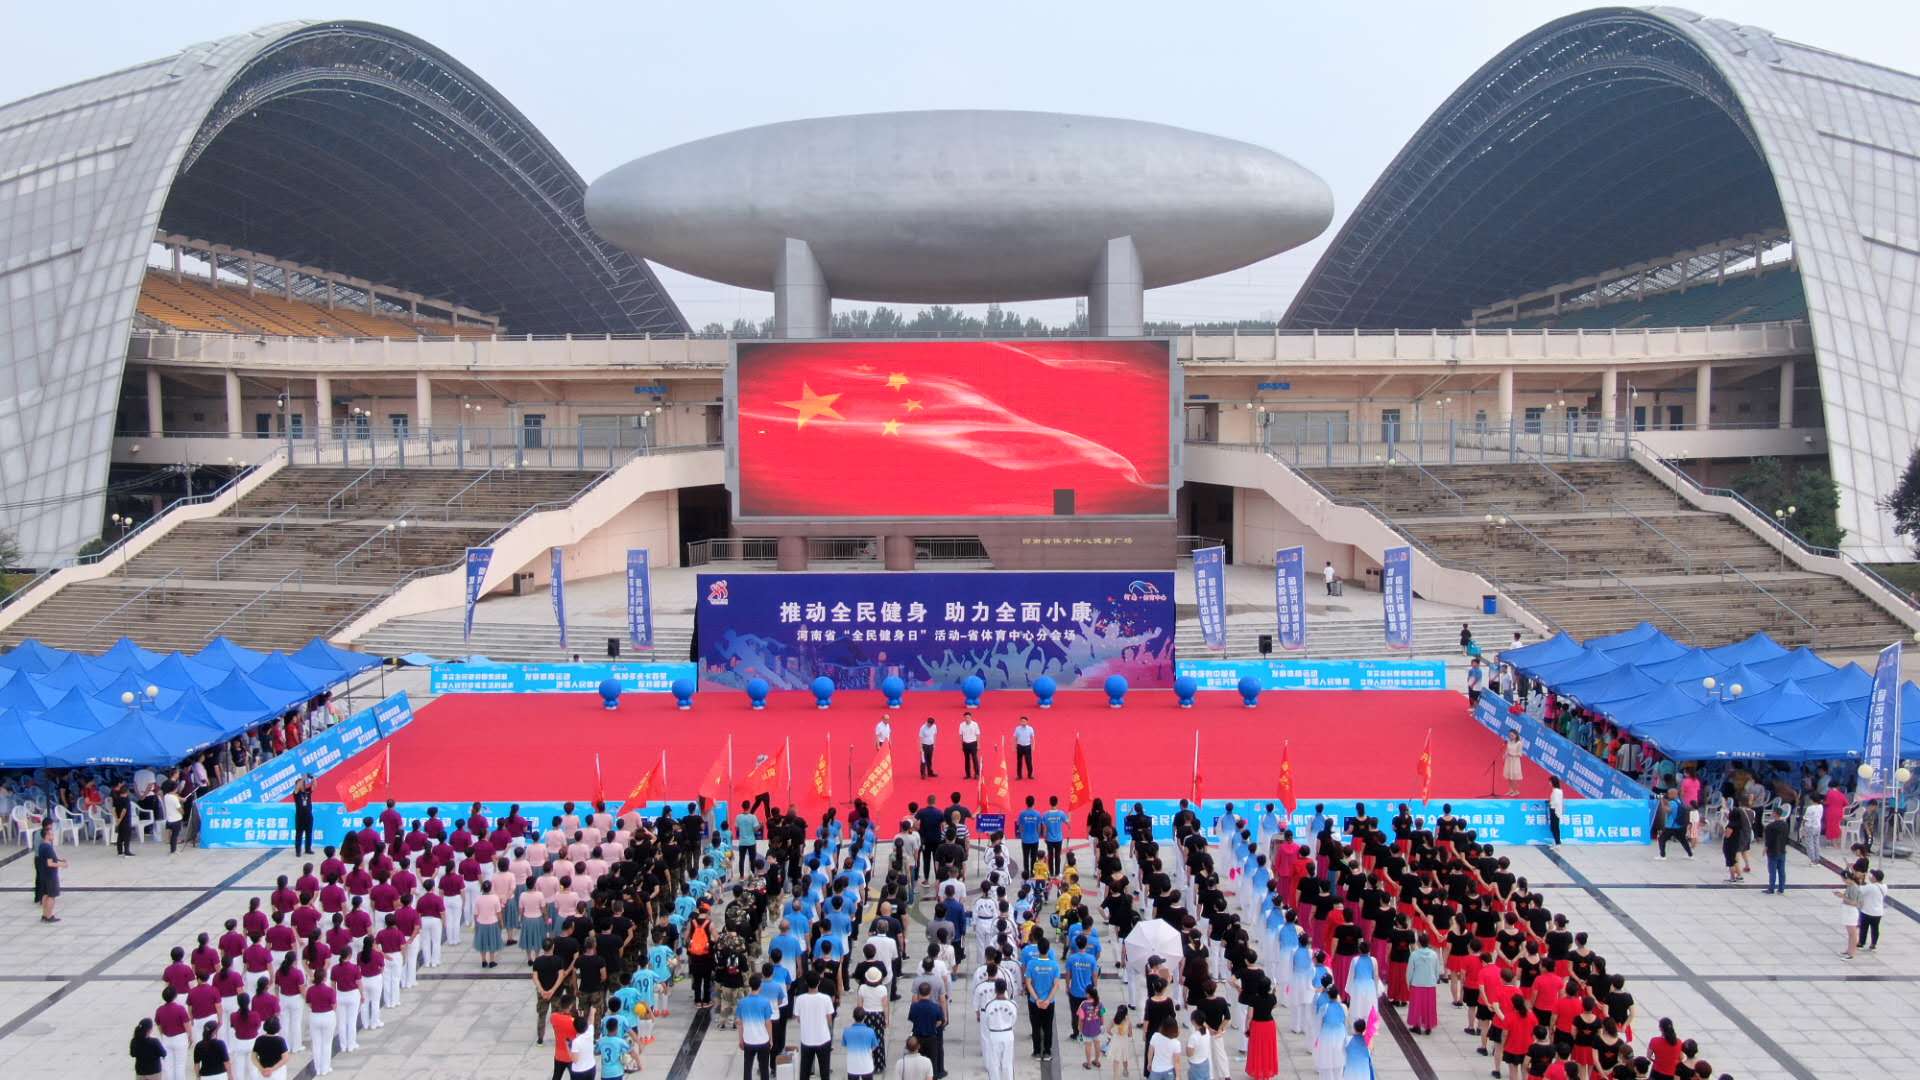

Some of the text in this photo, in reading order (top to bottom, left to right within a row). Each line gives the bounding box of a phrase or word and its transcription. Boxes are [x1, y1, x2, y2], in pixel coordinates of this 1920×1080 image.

[779, 601, 1092, 623] 推动全民健身 助力全面小康
[604, 1047, 612, 1063] 3
